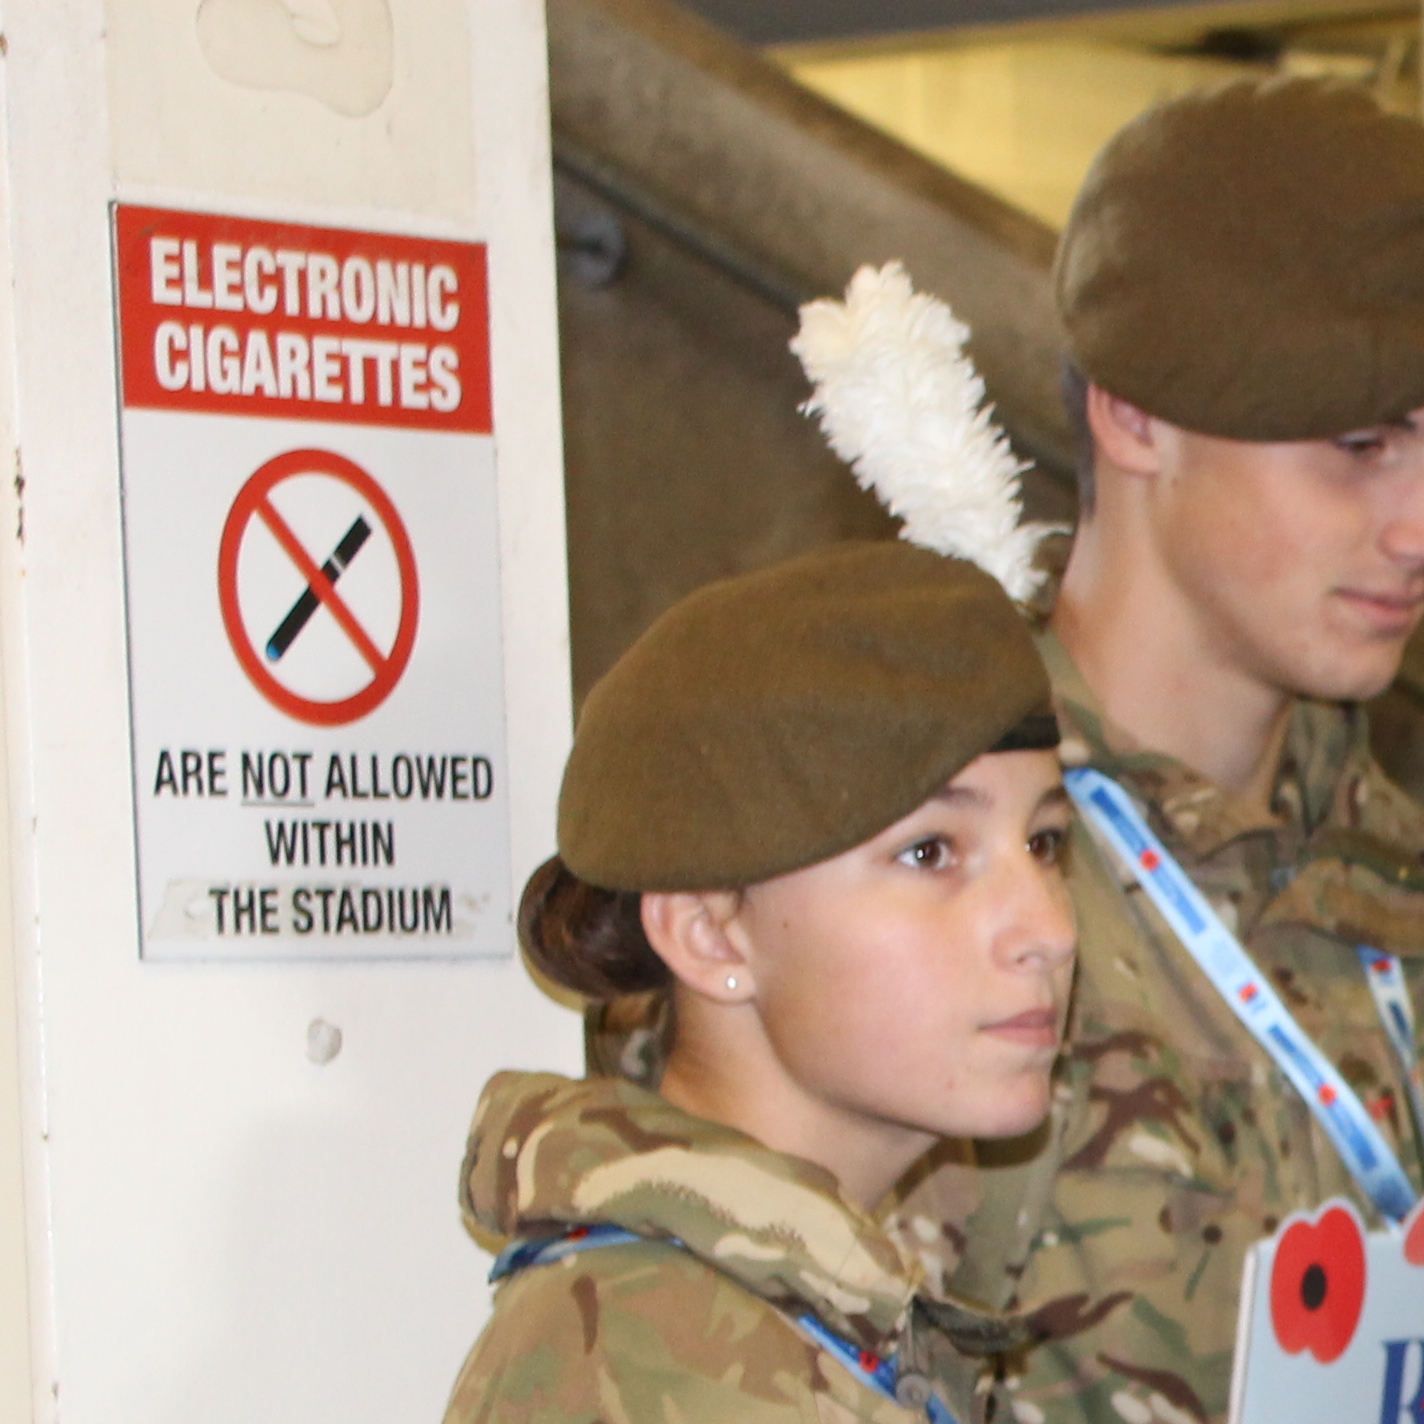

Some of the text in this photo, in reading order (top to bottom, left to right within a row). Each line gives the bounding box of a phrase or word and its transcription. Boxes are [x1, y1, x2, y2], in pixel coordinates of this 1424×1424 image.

[149, 236, 461, 331] ELECTRONIC
[153, 322, 462, 412] CIGARETTES
[154, 749, 495, 802] ARE NOT ALLOWED
[265, 819, 395, 869] WITHIN
[209, 887, 453, 936] THE STADIUM
